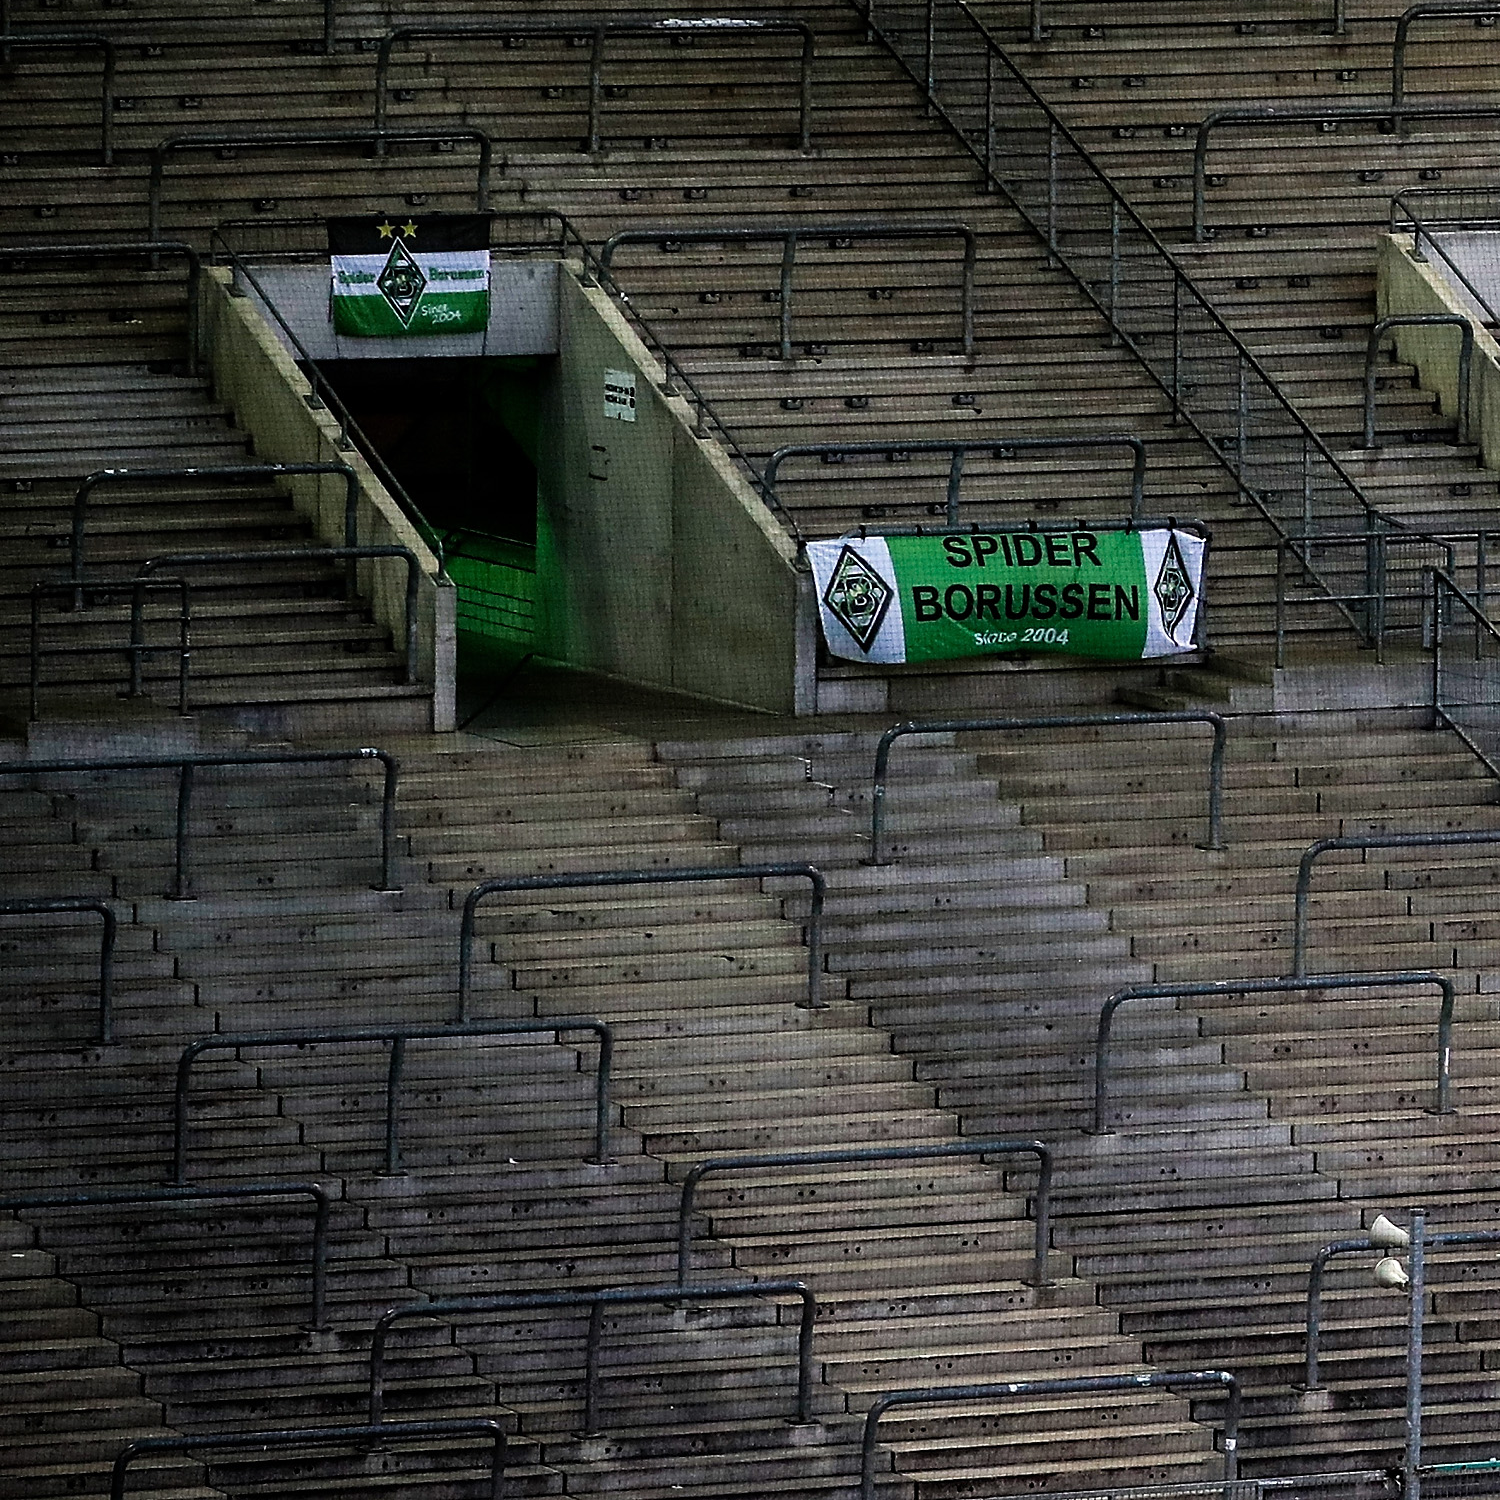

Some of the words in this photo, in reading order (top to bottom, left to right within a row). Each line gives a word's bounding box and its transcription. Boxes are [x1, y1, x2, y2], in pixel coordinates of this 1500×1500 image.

[942, 532, 1102, 567] SPIDER
[911, 584, 1140, 621] BORUSSEN
[1020, 628, 1070, 645] 2004
